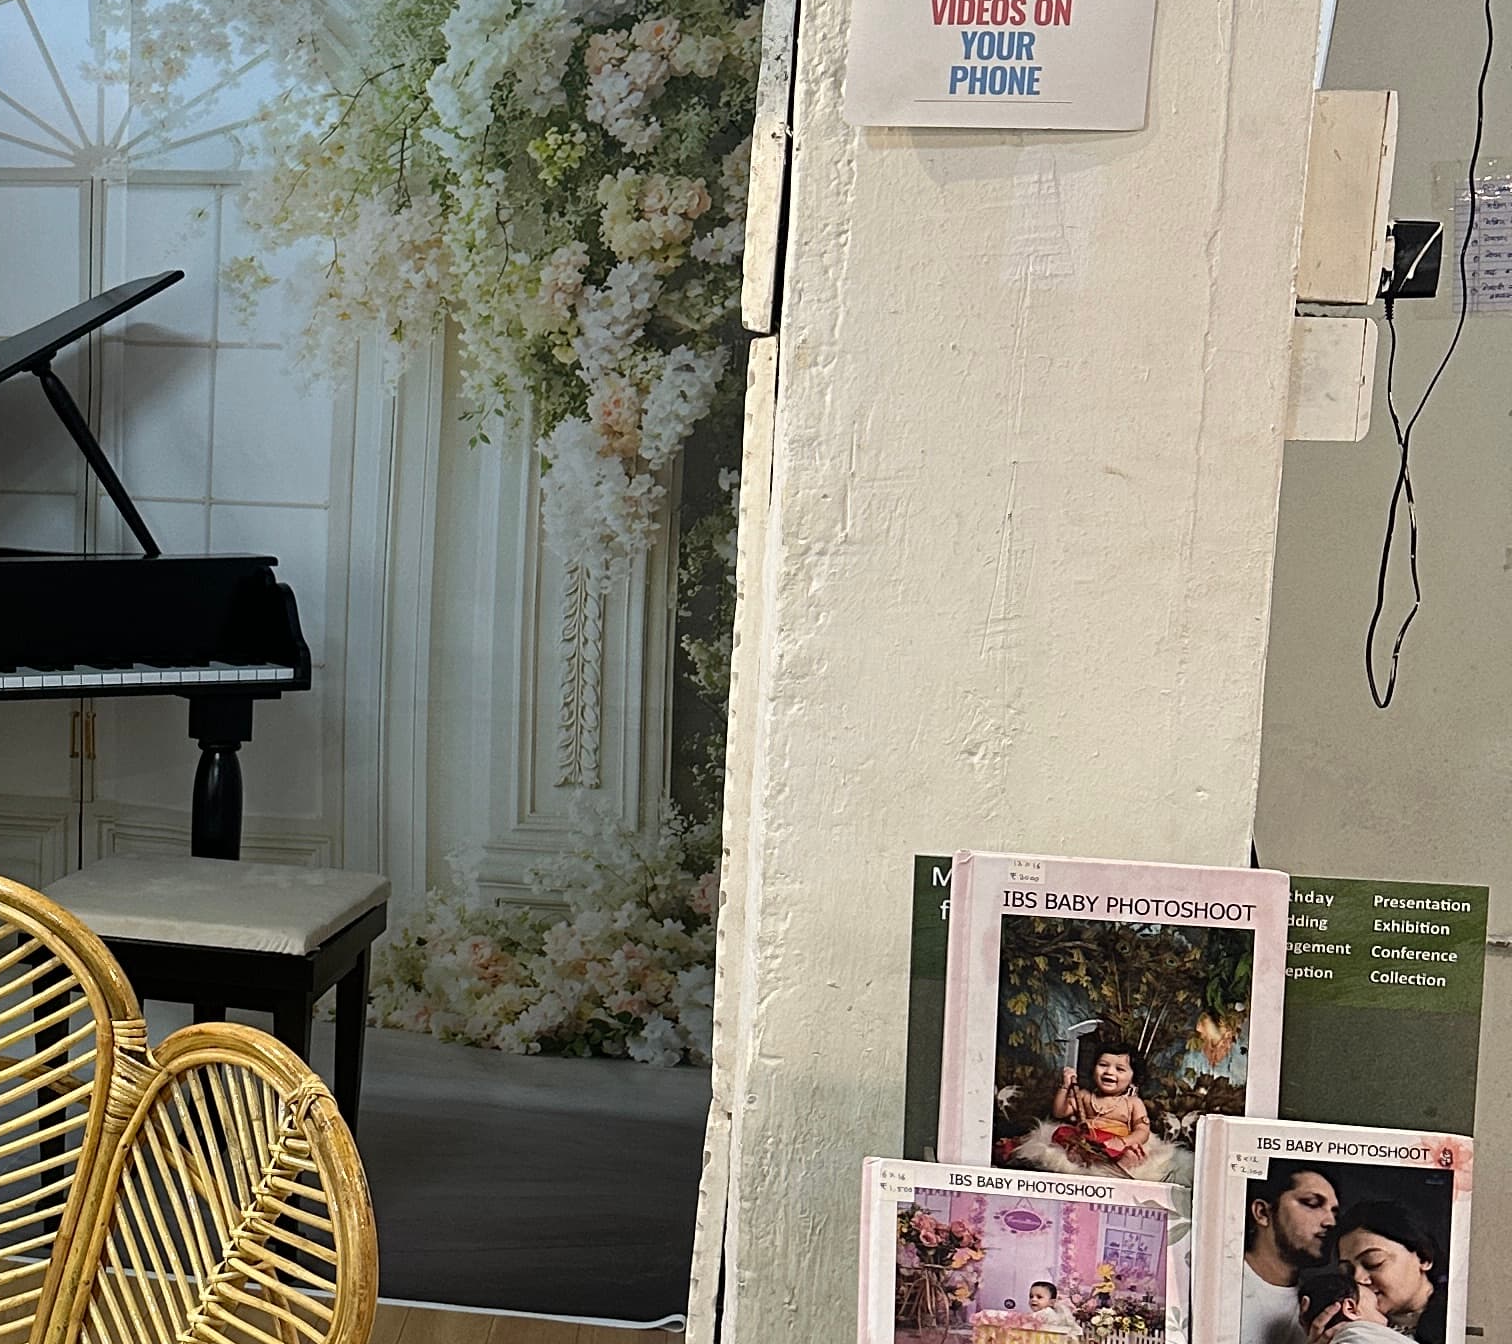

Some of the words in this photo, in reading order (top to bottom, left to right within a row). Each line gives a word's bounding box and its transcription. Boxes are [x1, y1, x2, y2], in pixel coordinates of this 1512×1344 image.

[961, 30, 1036, 60] YOUR
[948, 65, 1042, 96] PHONE
[1002, 890, 1038, 909] IBS
[1045, 893, 1100, 913] BABY
[1106, 896, 1257, 922] PHOTOSHOOT
[1373, 894, 1472, 913] Presentation
[1373, 919, 1451, 936] Exhibition
[1371, 945, 1459, 963] Conference
[1369, 970, 1447, 988] Collection
[1256, 1137, 1281, 1151] IBS
[1286, 1140, 1324, 1154] BABY
[1328, 1142, 1431, 1161] PHOTOSHOOT
[949, 1173, 973, 1187] IBS
[977, 1175, 1013, 1190] BABY
[1017, 1177, 1116, 1200] PHOTOSHOOT
